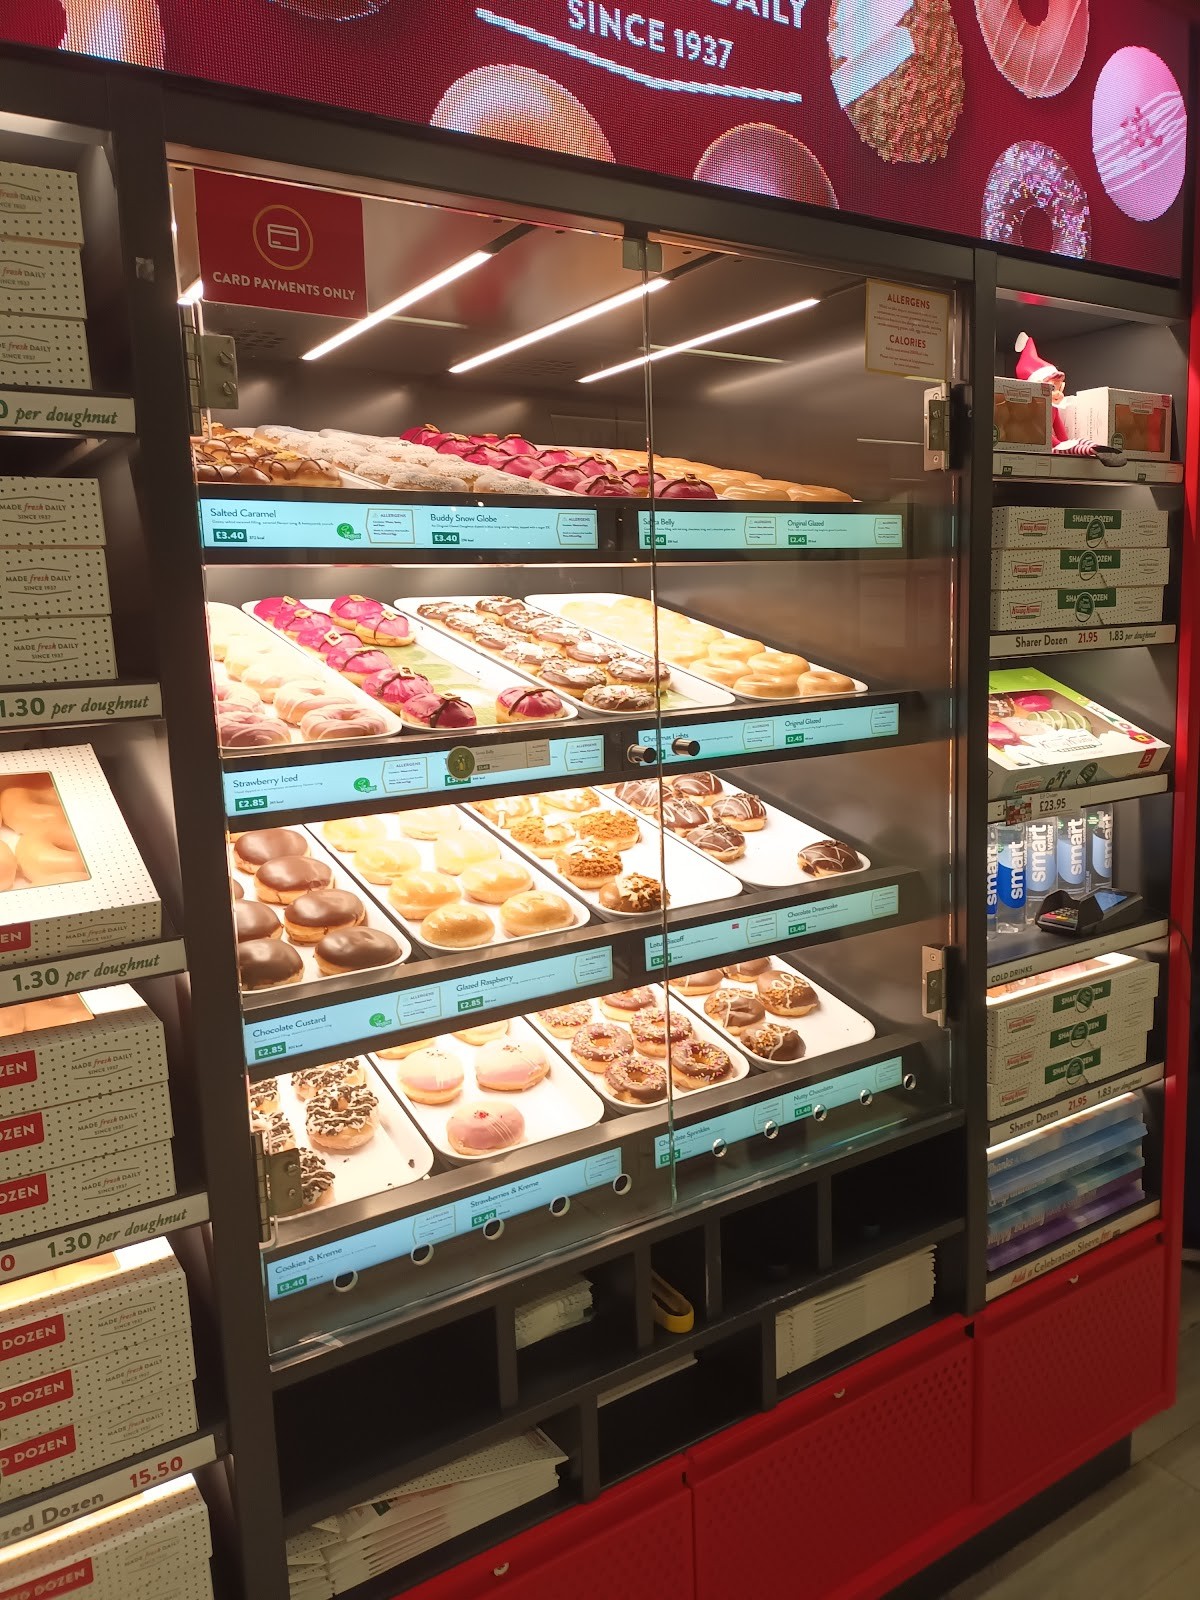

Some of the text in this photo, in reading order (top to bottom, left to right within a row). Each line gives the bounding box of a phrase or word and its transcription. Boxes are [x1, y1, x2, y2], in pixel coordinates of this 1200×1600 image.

[711, 0, 805, 28] AILY
[567, 4, 734, 70] SINCE 1937
[20, 193, 42, 202] DAILY
[24, 270, 46, 278] DAILY
[212, 271, 356, 300] CARD PAYMENTS ONLY
[887, 293, 930, 310] ALLERGENS
[8, 342, 28, 351] fresh
[30, 344, 51, 352] DAILY
[889, 334, 926, 348] CALORIES
[14, 406, 118, 428] per doughnut
[22, 502, 44, 512] fresh
[210, 508, 276, 518] Salted Caramel
[430, 513, 497, 523] Buddy Snow Globe
[661, 518, 675, 527] Belly
[787, 520, 807, 528] Original
[216, 531, 244, 540] £3.40
[434, 534, 457, 542] £3.40
[29, 573, 49, 582] fresh
[50, 574, 72, 582] DAILY
[1015, 630, 1156, 647] Sharer Dozen 21.95 1.83 per doughnut
[37, 642, 57, 652] fresh
[58, 642, 79, 650] DAILY
[51, 704, 76, 719] per
[80, 695, 150, 715] doughnut
[785, 719, 804, 728] Original
[233, 776, 279, 788] Strawberry
[281, 774, 298, 783] Iced
[238, 798, 264, 808] £2.85
[1040, 798, 1066, 812] £23.95
[1029, 824, 1046, 882] smart
[1068, 818, 1083, 876] smart
[1008, 841, 1024, 899] smart
[788, 904, 838, 918] Chocolate Dreamcake
[66, 932, 86, 940] MADE
[107, 925, 128, 933] DAILY
[13, 954, 160, 992] 1.30 per doughnut
[991, 966, 1033, 982] COLD DRINKS
[456, 981, 479, 992] Glazed
[480, 974, 514, 987] Raspberry
[460, 999, 481, 1009] £2.85
[252, 1024, 294, 1038] Chocolate
[295, 1015, 326, 1028] Custard
[258, 1045, 283, 1056] £2.85
[71, 1053, 133, 1070] MADE fresh DAILY
[88, 1067, 106, 1075] SINCE
[794, 1093, 808, 1101] Nutty
[1009, 1120, 1034, 1134] Sharer
[1036, 1110, 1058, 1124] Dozen
[1068, 1096, 1087, 1110] 21.95
[1098, 1087, 1112, 1098] 1.83
[78, 1112, 138, 1131] MADE fresh DAILY
[94, 1127, 111, 1135] SINCE
[687, 1126, 710, 1138] Sprinkles
[81, 1171, 142, 1192] MADE fresh DAILY
[97, 1187, 115, 1195] SINCE
[470, 1191, 510, 1208] Strawberries
[518, 1181, 539, 1192] Kreme
[473, 1212, 494, 1224] £3.40
[47, 1232, 92, 1258] 1.30
[96, 1231, 120, 1249] per
[124, 1208, 187, 1234] doughnut
[275, 1260, 306, 1274] Cookies
[316, 1248, 342, 1260] Kreme
[1011, 1268, 1027, 1285] Add
[1034, 1247, 1076, 1273] Celebration
[1078, 1237, 1099, 1252] Sleeve
[279, 1278, 305, 1292] £3.40
[98, 1305, 157, 1328] MADE fresh DAILY
[114, 1322, 130, 1330] SINCE
[2, 1324, 57, 1351] DOZEN
[105, 1372, 125, 1383] MADE
[144, 1359, 163, 1369] DAILY
[11, 1380, 65, 1406] DOZEN
[14, 1436, 68, 1464] DOZEN
[0, 1456, 183, 1540] zed Dozen 15.50
[34, 1568, 85, 1596] DOZEN
